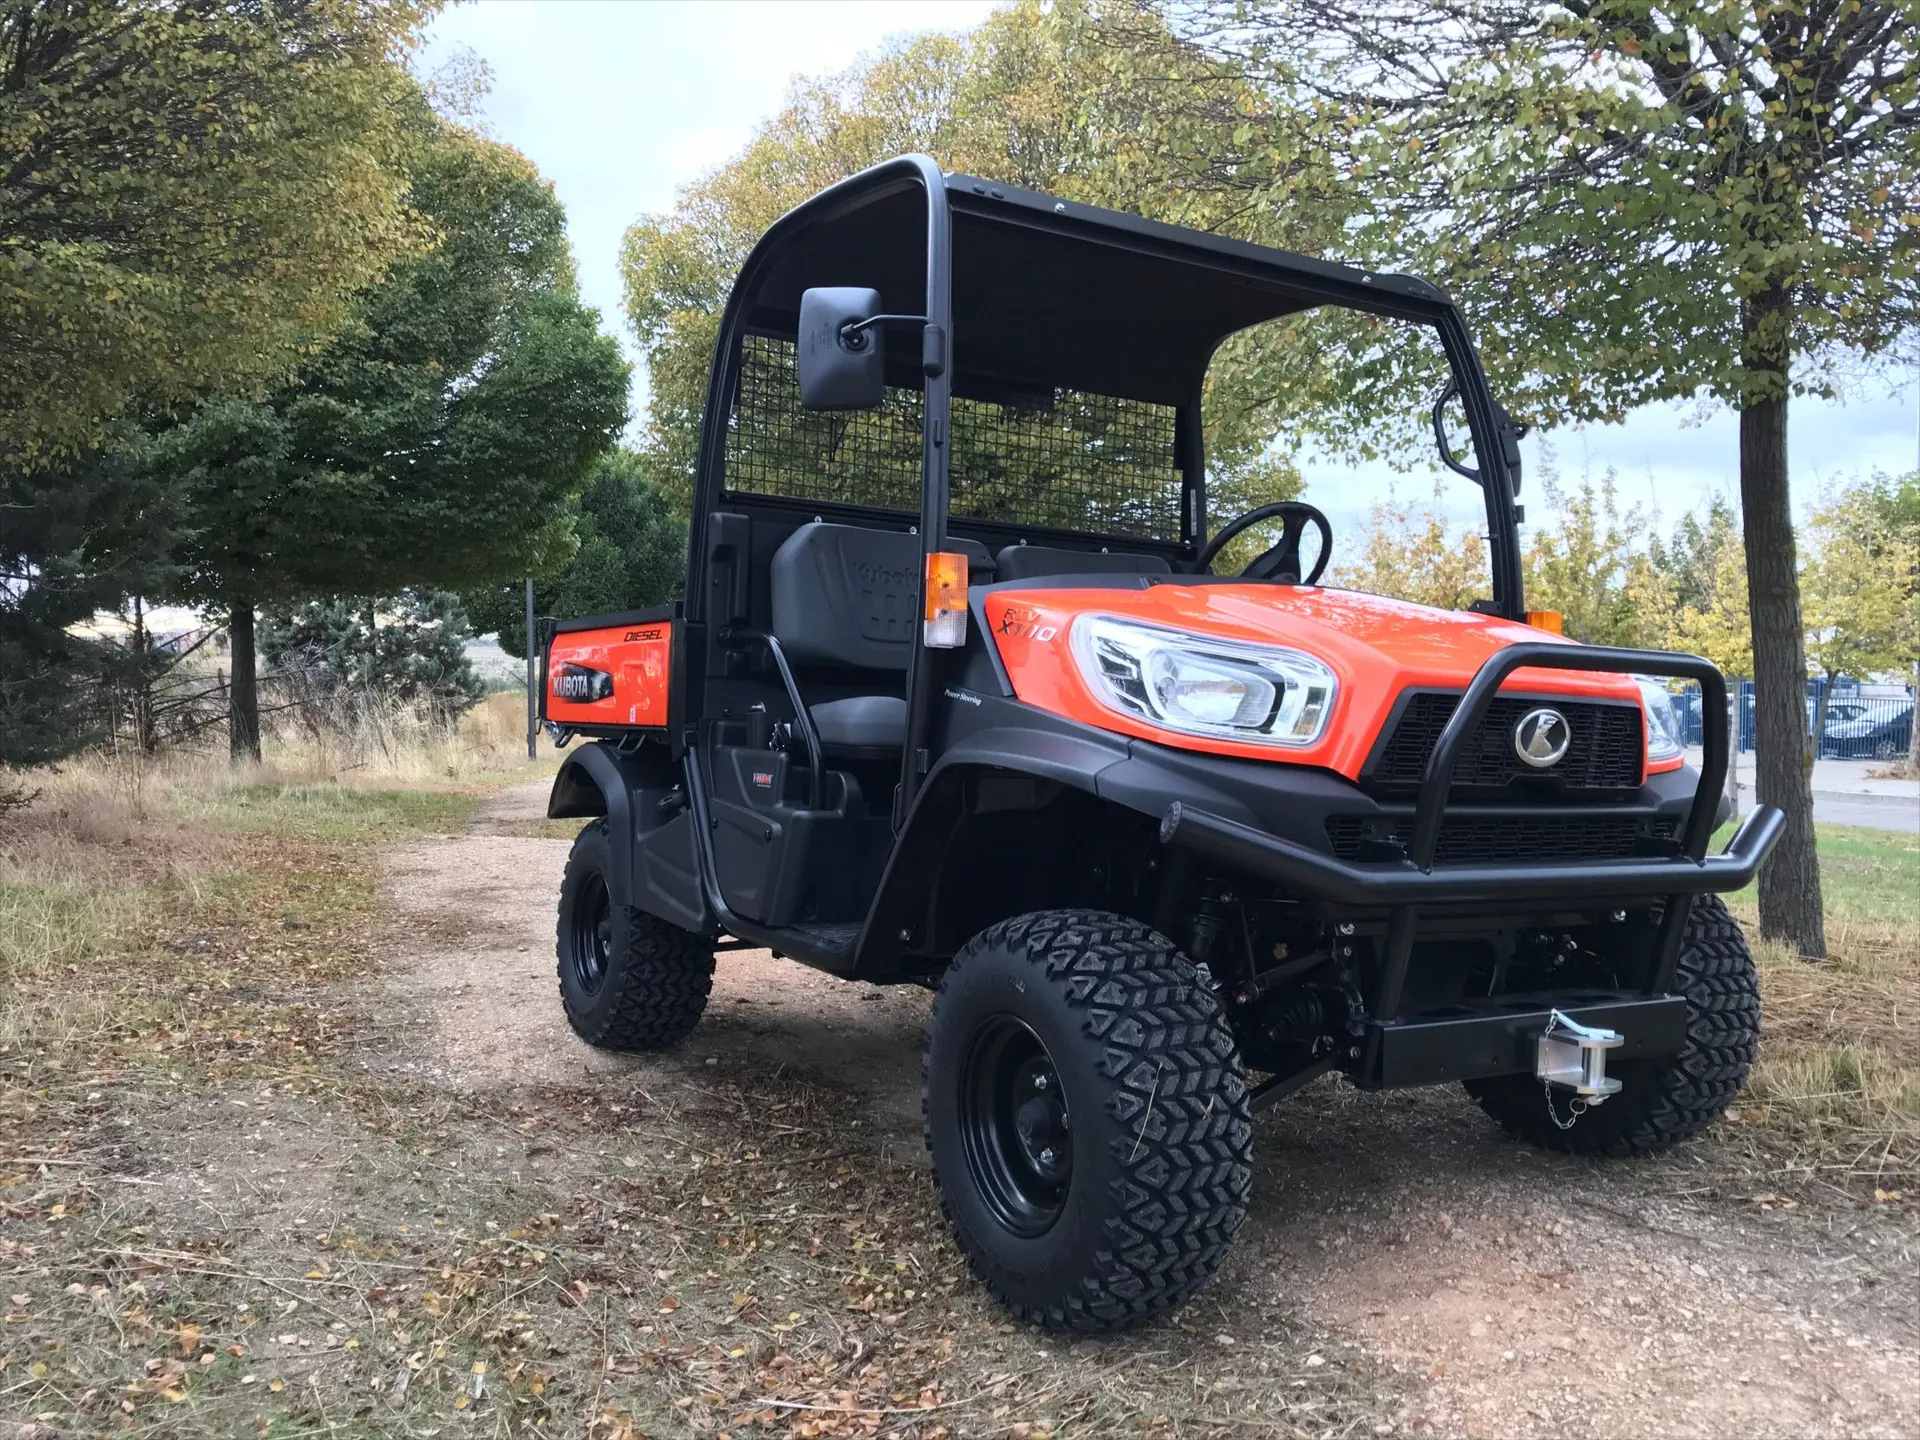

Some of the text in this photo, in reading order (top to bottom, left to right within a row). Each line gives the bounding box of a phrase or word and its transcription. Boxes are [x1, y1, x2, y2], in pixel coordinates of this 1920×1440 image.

[852, 561, 919, 586] Kubot
[1004, 608, 1041, 622] RTV
[624, 630, 663, 642] DIESEL
[553, 675, 588, 697] KUBOTA
